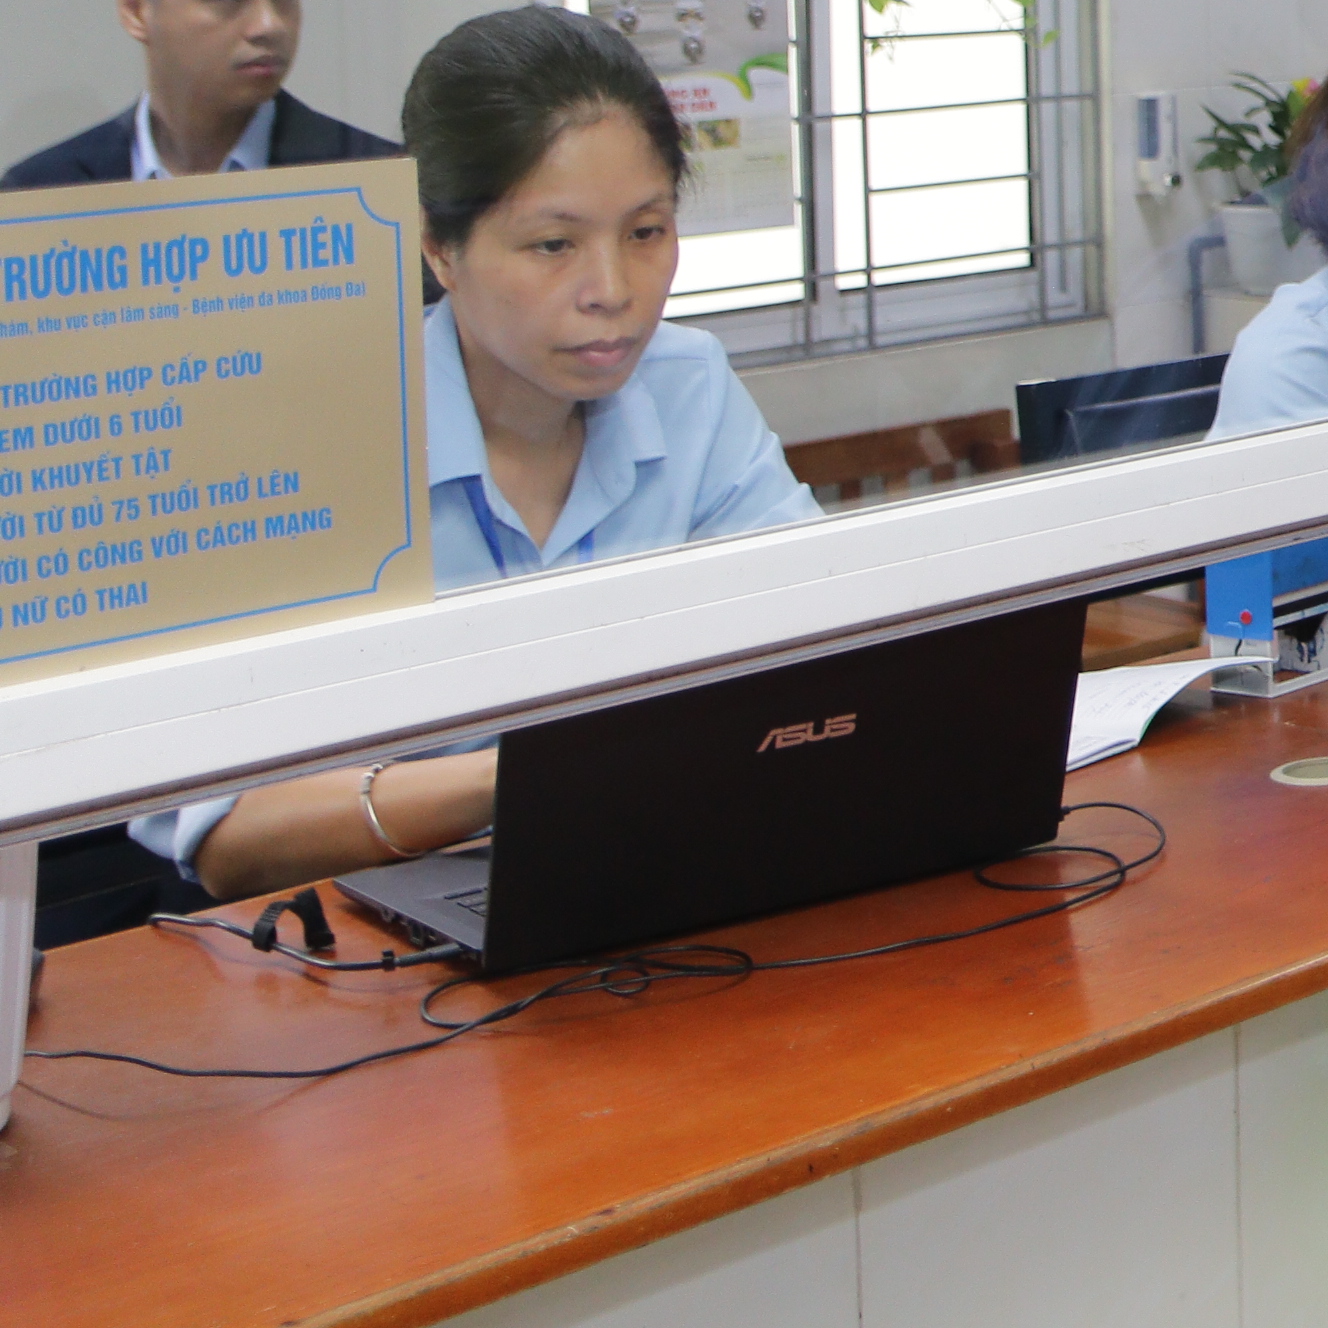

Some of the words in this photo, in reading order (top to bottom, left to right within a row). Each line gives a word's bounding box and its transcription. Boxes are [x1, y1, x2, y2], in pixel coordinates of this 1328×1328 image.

[0, 239, 128, 303] RƯỜNG
[140, 234, 210, 294] HỢP
[222, 228, 269, 278] ƯU
[279, 215, 355, 272] TIÊN
[37, 317, 62, 334] khu
[121, 306, 145, 324] lâm
[149, 303, 180, 320] sàng
[192, 296, 224, 318] Bệnh
[228, 292, 254, 313] viện
[258, 291, 273, 307] đa
[277, 288, 307, 306] khoa
[0, 372, 98, 409] TRƯỜNG
[105, 365, 153, 398] HỢP
[160, 352, 208, 387] CẤP
[215, 350, 263, 380] CỨU
[0, 426, 35, 454] EM
[43, 413, 101, 447] DƯỚI
[109, 414, 123, 438] 6
[130, 396, 183, 434] TUỔI
[31, 451, 123, 493] KHUYẾT
[131, 446, 172, 480] TẬT
[33, 504, 66, 536] TỪ
[71, 494, 104, 531] ĐỦ
[111, 497, 141, 522] 75
[148, 479, 199, 516] TUỔI
[206, 472, 249, 507] TRỞ
[256, 469, 299, 500] LÊN
[36, 547, 69, 579] CÓ
[77, 539, 143, 572] CÔNG
[151, 528, 188, 560] VỚI
[196, 520, 258, 552] CÁCH
[264, 506, 333, 540] MẠNG
[11, 595, 48, 628] NỮ
[55, 587, 87, 620] CÓ
[95, 580, 148, 612] THAI
[756, 713, 857, 753] ASUS
